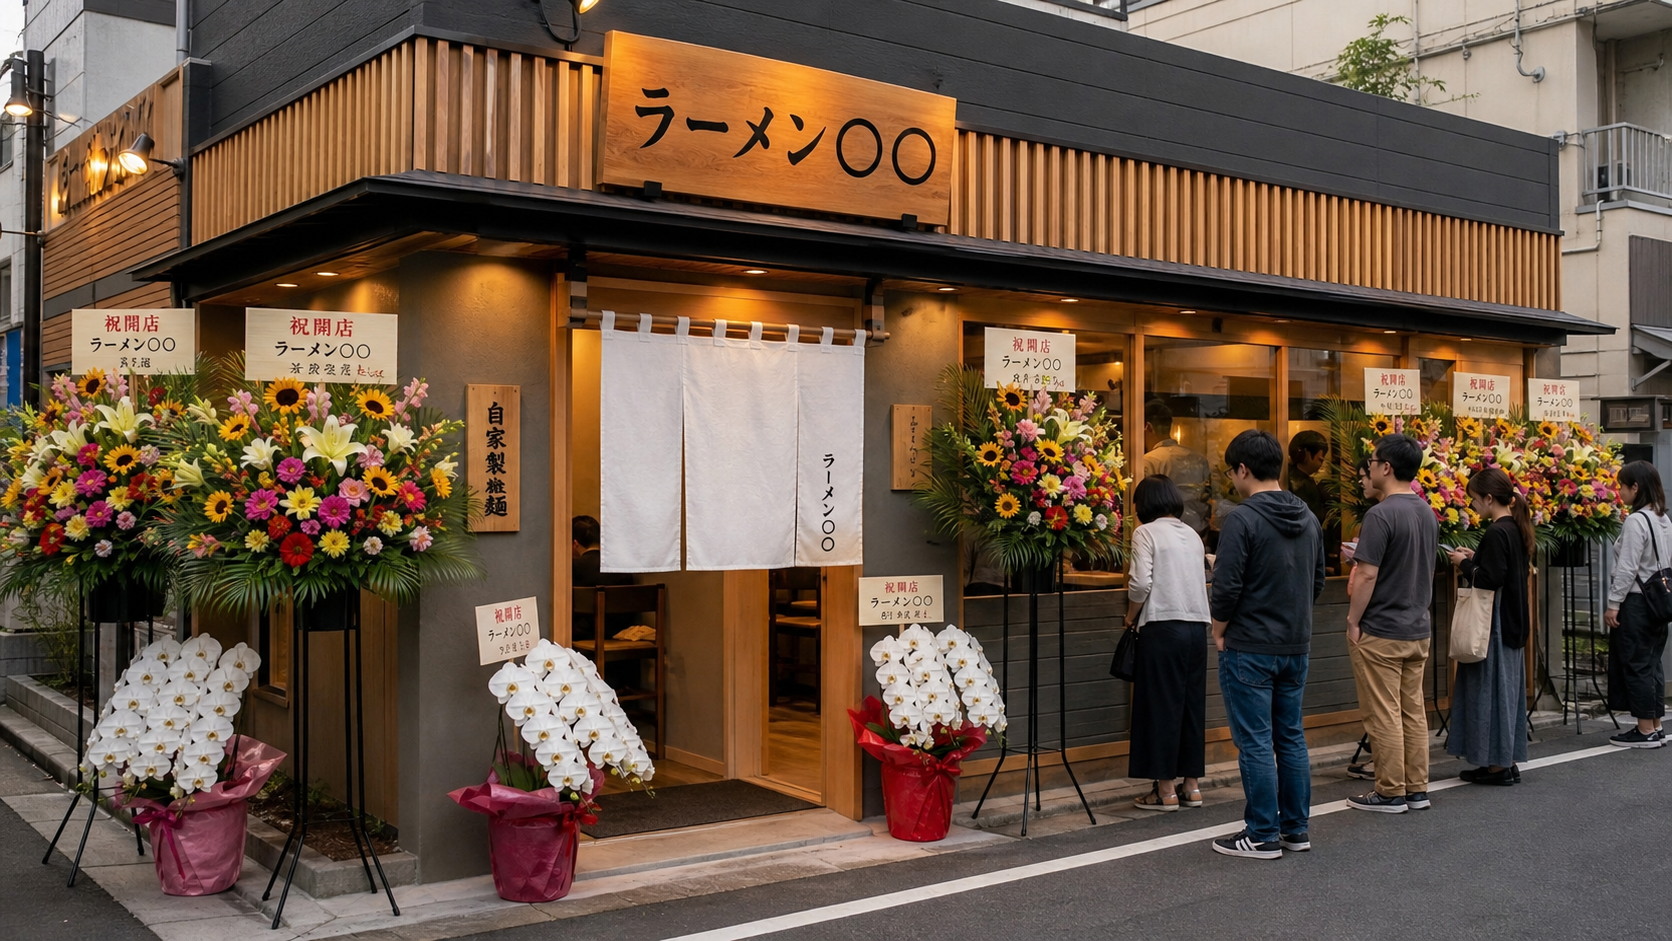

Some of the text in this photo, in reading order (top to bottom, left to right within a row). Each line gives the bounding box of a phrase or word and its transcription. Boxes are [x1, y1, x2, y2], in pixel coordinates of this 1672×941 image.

[105, 315, 159, 332] 祝開店
[290, 316, 353, 337] 祝開店
[1013, 336, 1050, 353] 祝開店
[884, 581, 918, 593] 祝開店
[494, 604, 522, 624] 祝開店
